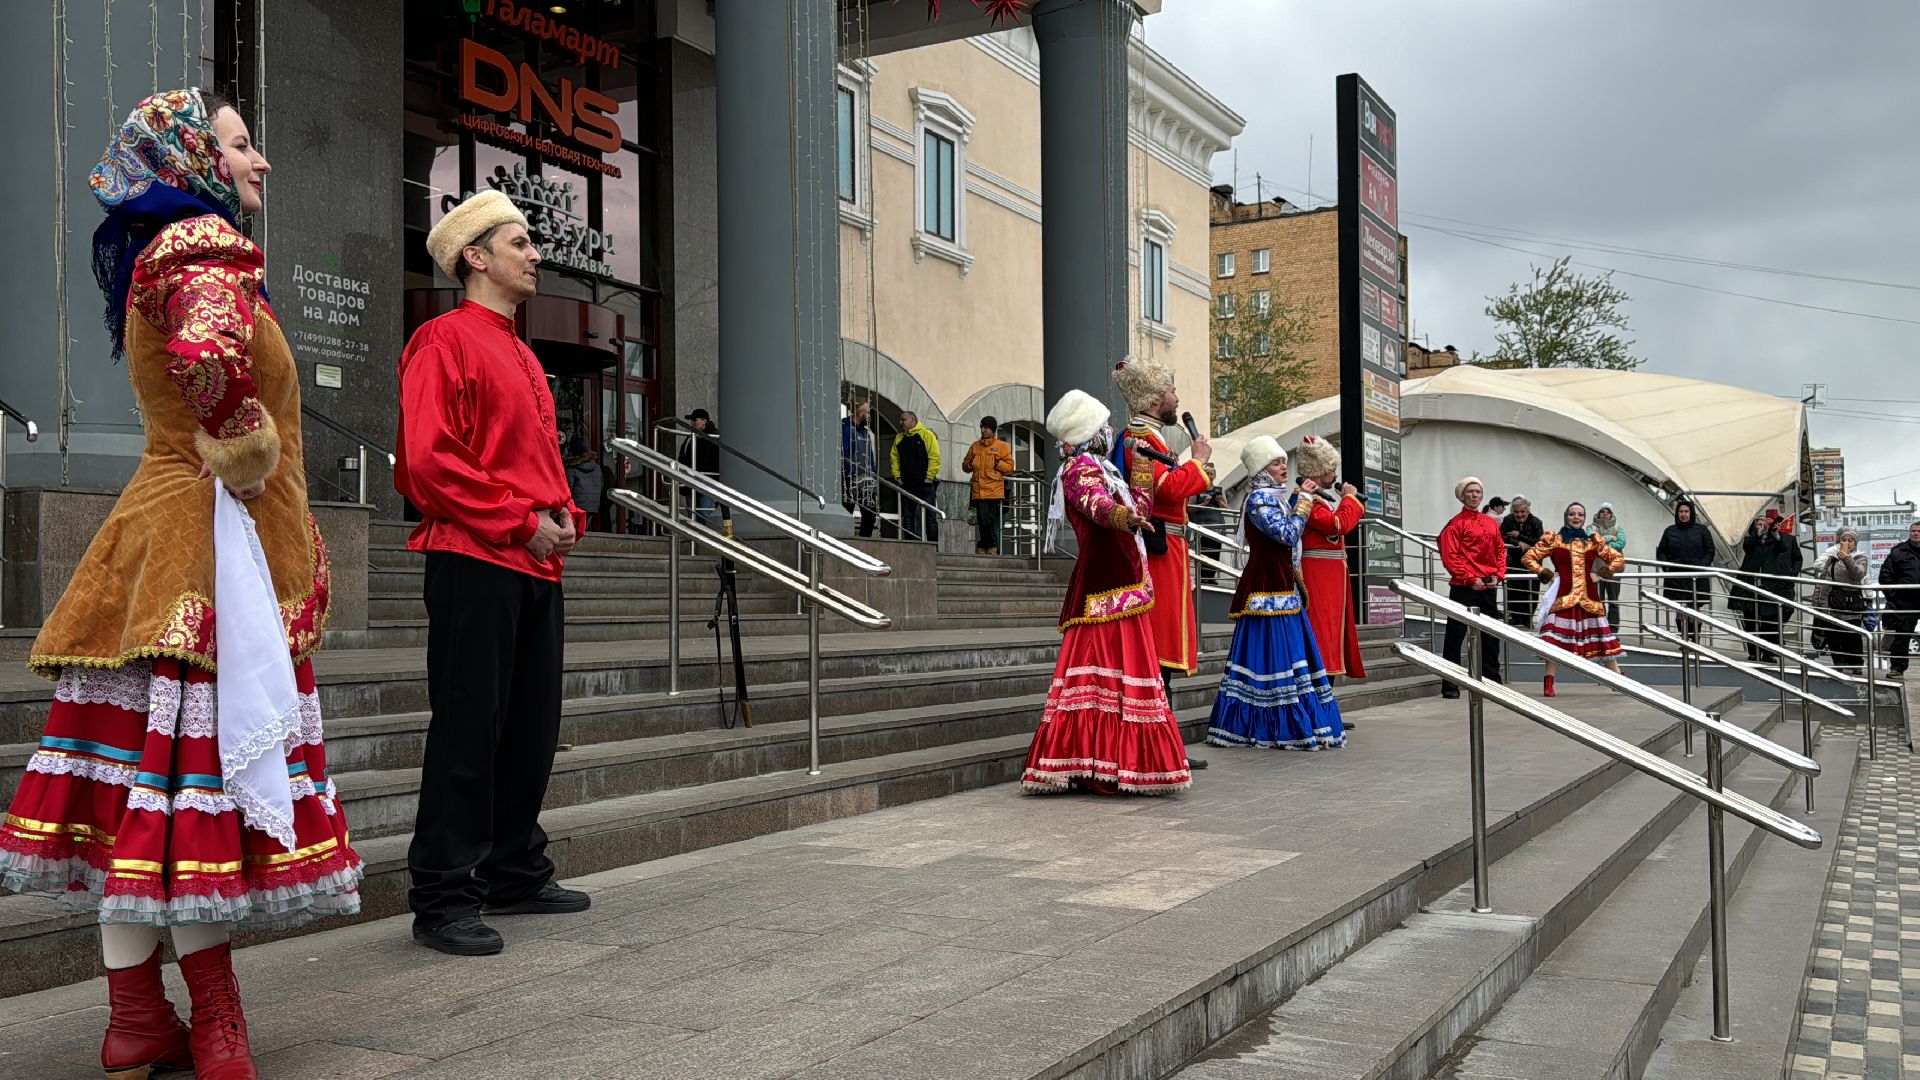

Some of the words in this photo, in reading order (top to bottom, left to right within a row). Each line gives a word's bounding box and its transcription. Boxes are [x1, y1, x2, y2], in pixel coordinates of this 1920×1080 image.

[459, 38, 622, 153] DNS
[463, 113, 523, 144] ЦИФРОВАЯ
[525, 134, 533, 148] И
[535, 138, 581, 165] БЫТОВАЯ
[582, 154, 622, 178] ТЕХНИКА
[568, 246, 615, 277] ЛАВКА
[292, 264, 370, 295] Доставка
[297, 285, 366, 310] товаров
[303, 305, 323, 320] на
[327, 309, 360, 327] дом
[296, 343, 366, 362] www.opadvor.ru
